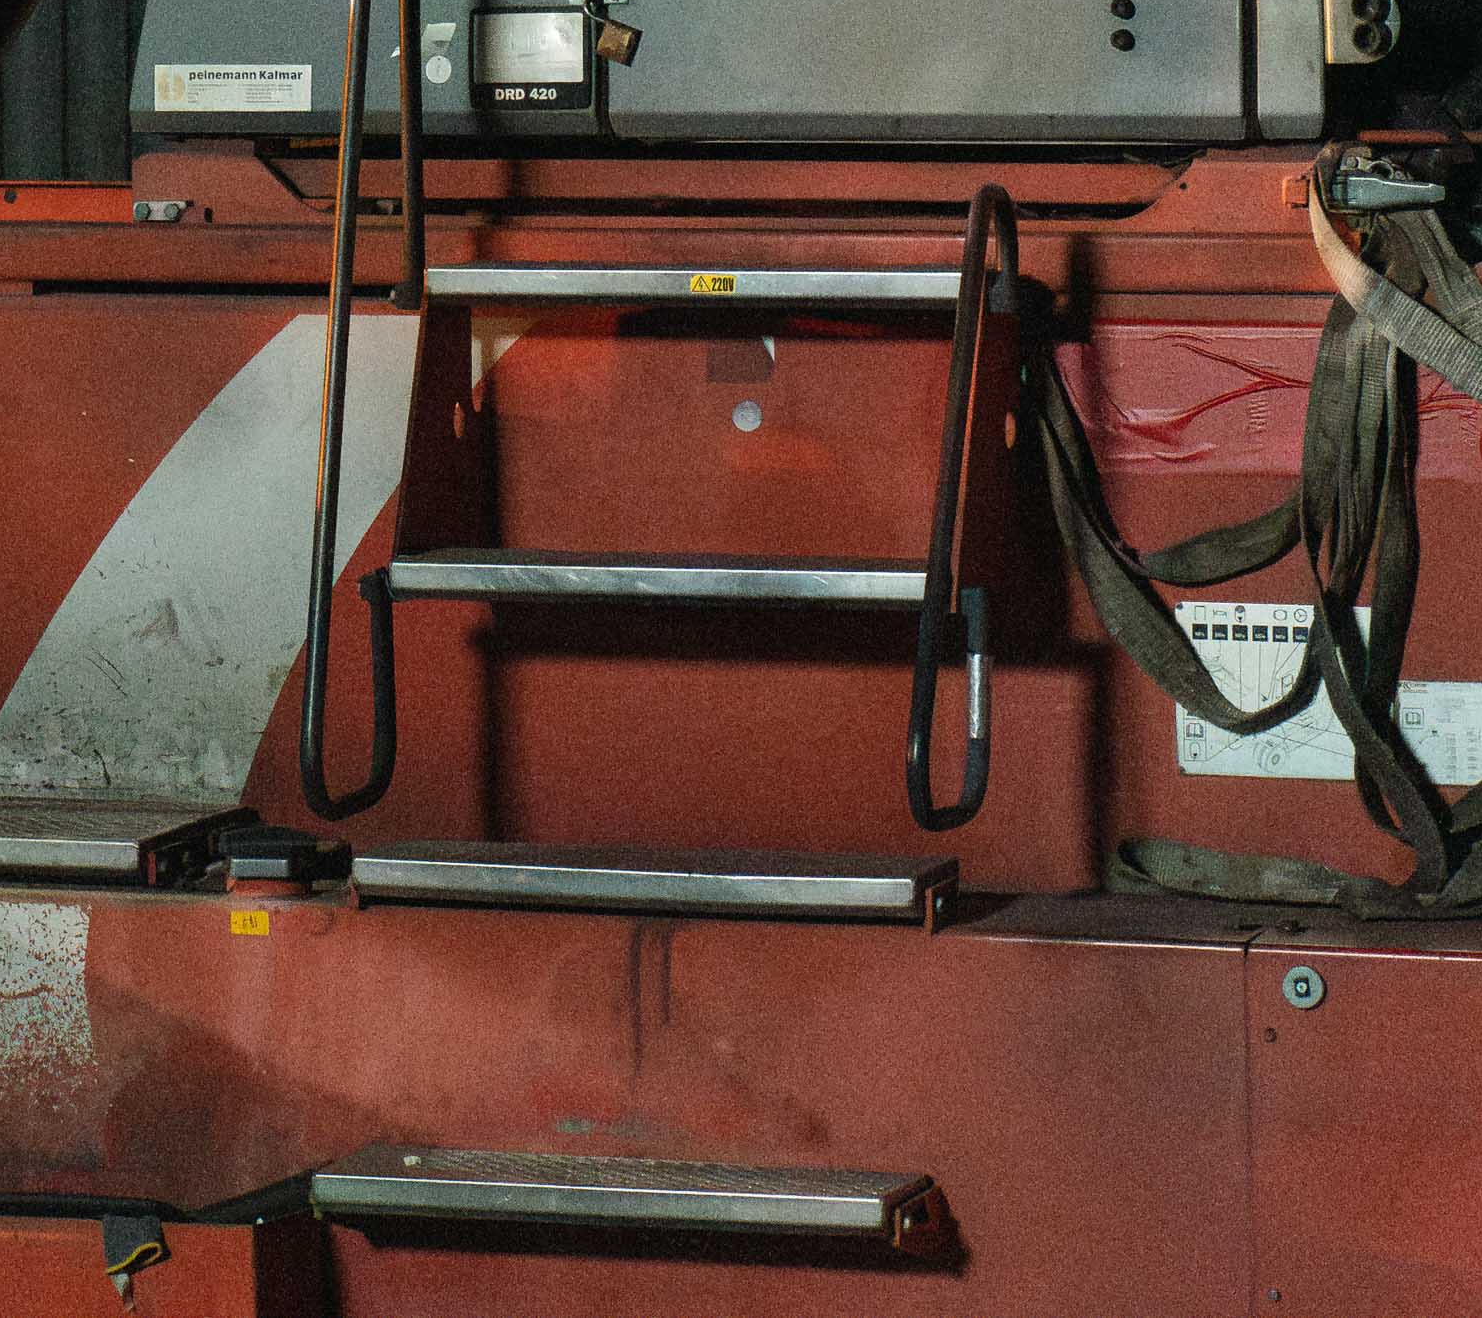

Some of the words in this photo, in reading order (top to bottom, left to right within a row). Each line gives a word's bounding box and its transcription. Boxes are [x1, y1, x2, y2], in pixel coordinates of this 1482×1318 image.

[188, 70, 257, 81] peinemann
[259, 70, 303, 81] Kalmar
[494, 88, 526, 101] DRD
[529, 87, 557, 101] 420
[711, 276, 734, 293] 220V
